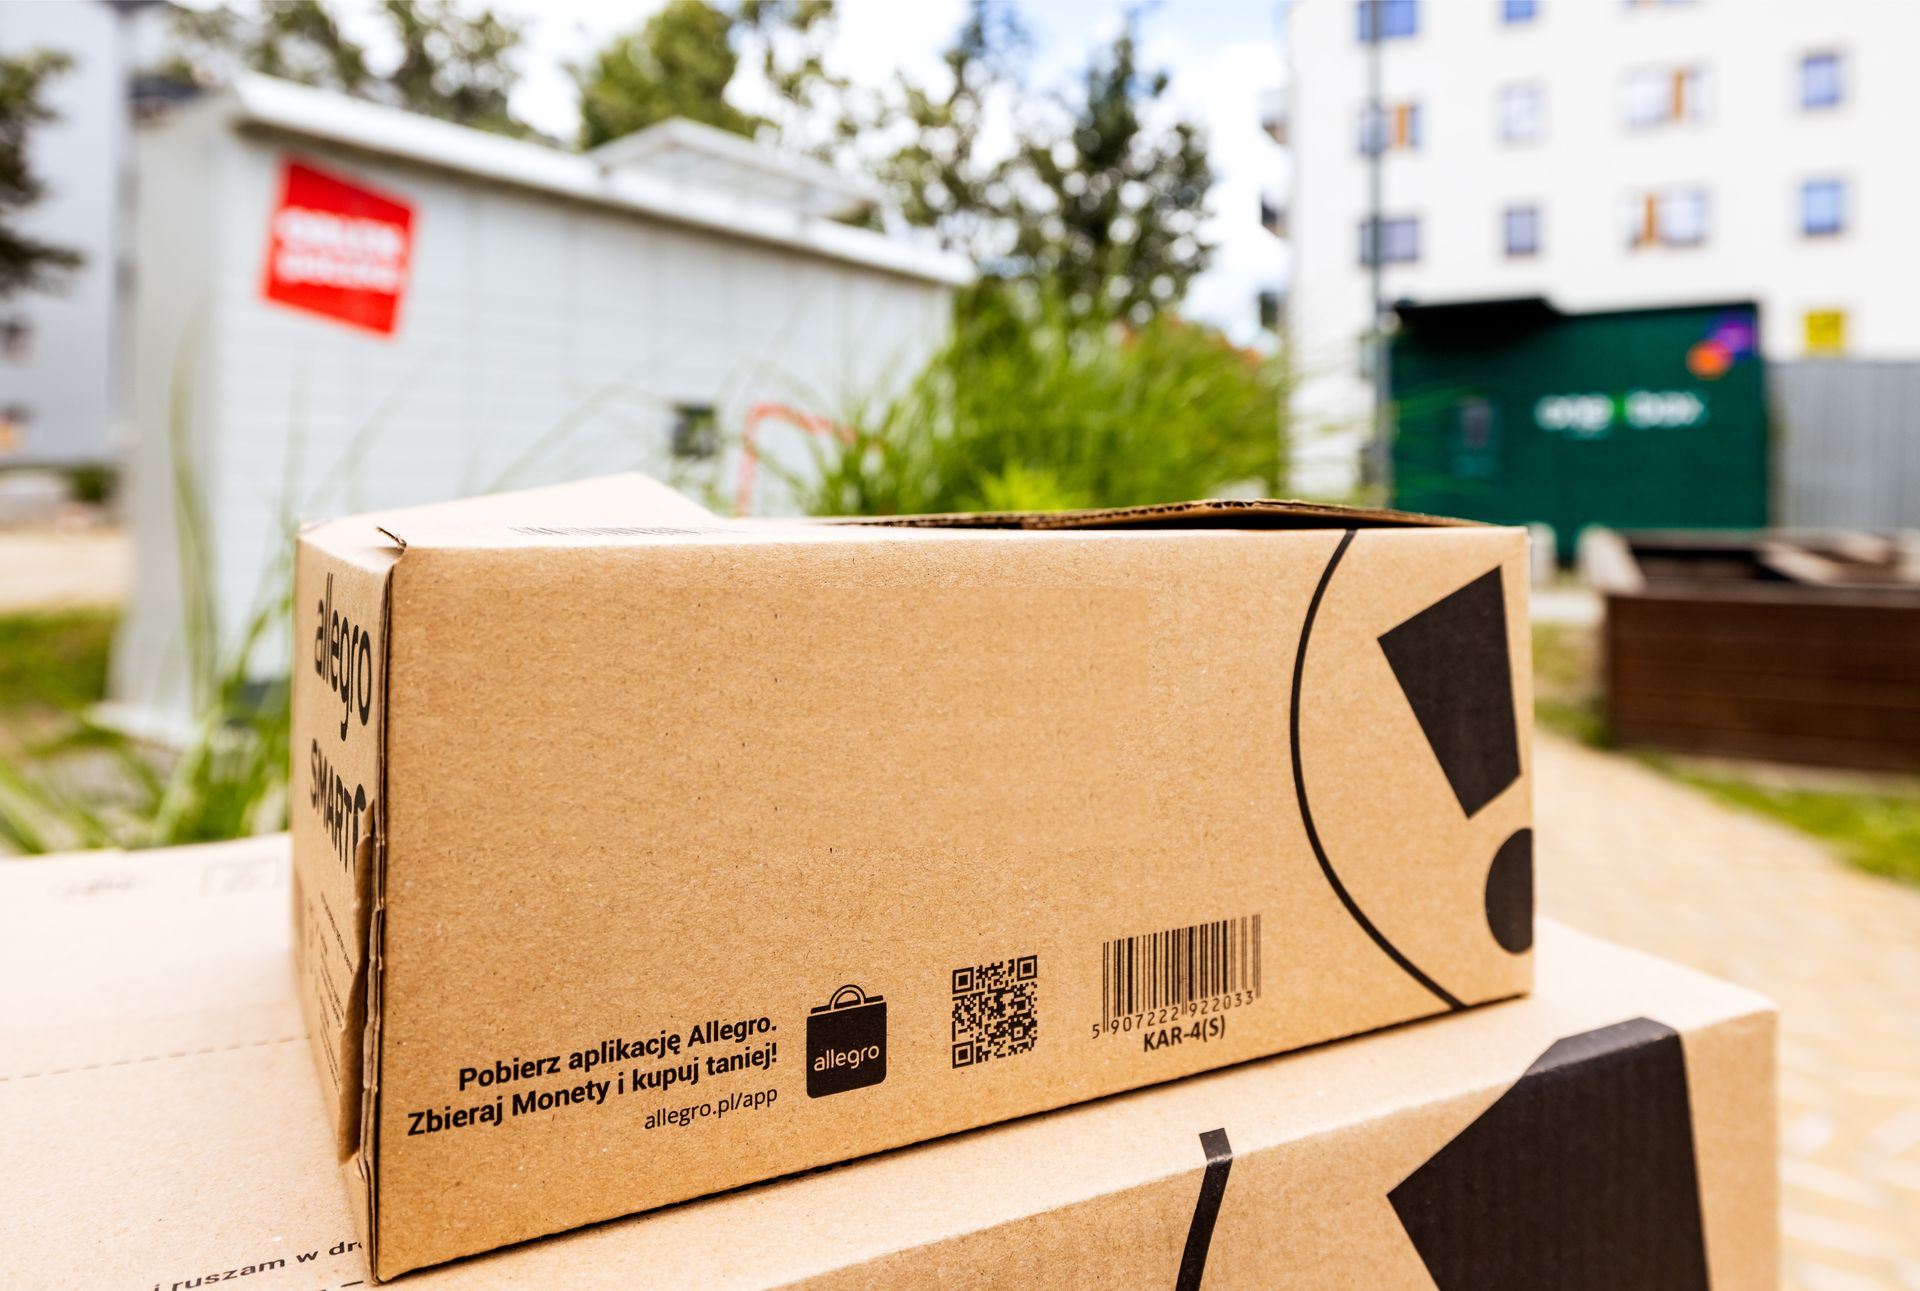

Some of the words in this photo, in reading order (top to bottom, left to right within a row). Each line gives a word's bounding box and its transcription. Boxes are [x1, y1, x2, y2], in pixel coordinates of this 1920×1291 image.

[315, 571, 372, 742] allegro
[459, 1055, 561, 1092] Pobierz
[568, 1030, 681, 1073] aplikację
[688, 1016, 777, 1048] Allegro.
[813, 1045, 880, 1072] allegro
[1143, 1014, 1226, 1053] KAR-4(S)
[407, 1095, 503, 1137] Zbieraj
[512, 1079, 611, 1117] Monety
[618, 1072, 625, 1095] i
[632, 1057, 699, 1092] kupuj
[705, 1043, 777, 1076] taniej!
[644, 1088, 778, 1130] allegro.pl/app
[171, 1258, 286, 1291] ruszam
[295, 1250, 319, 1263] w
[328, 1241, 363, 1256] dr
